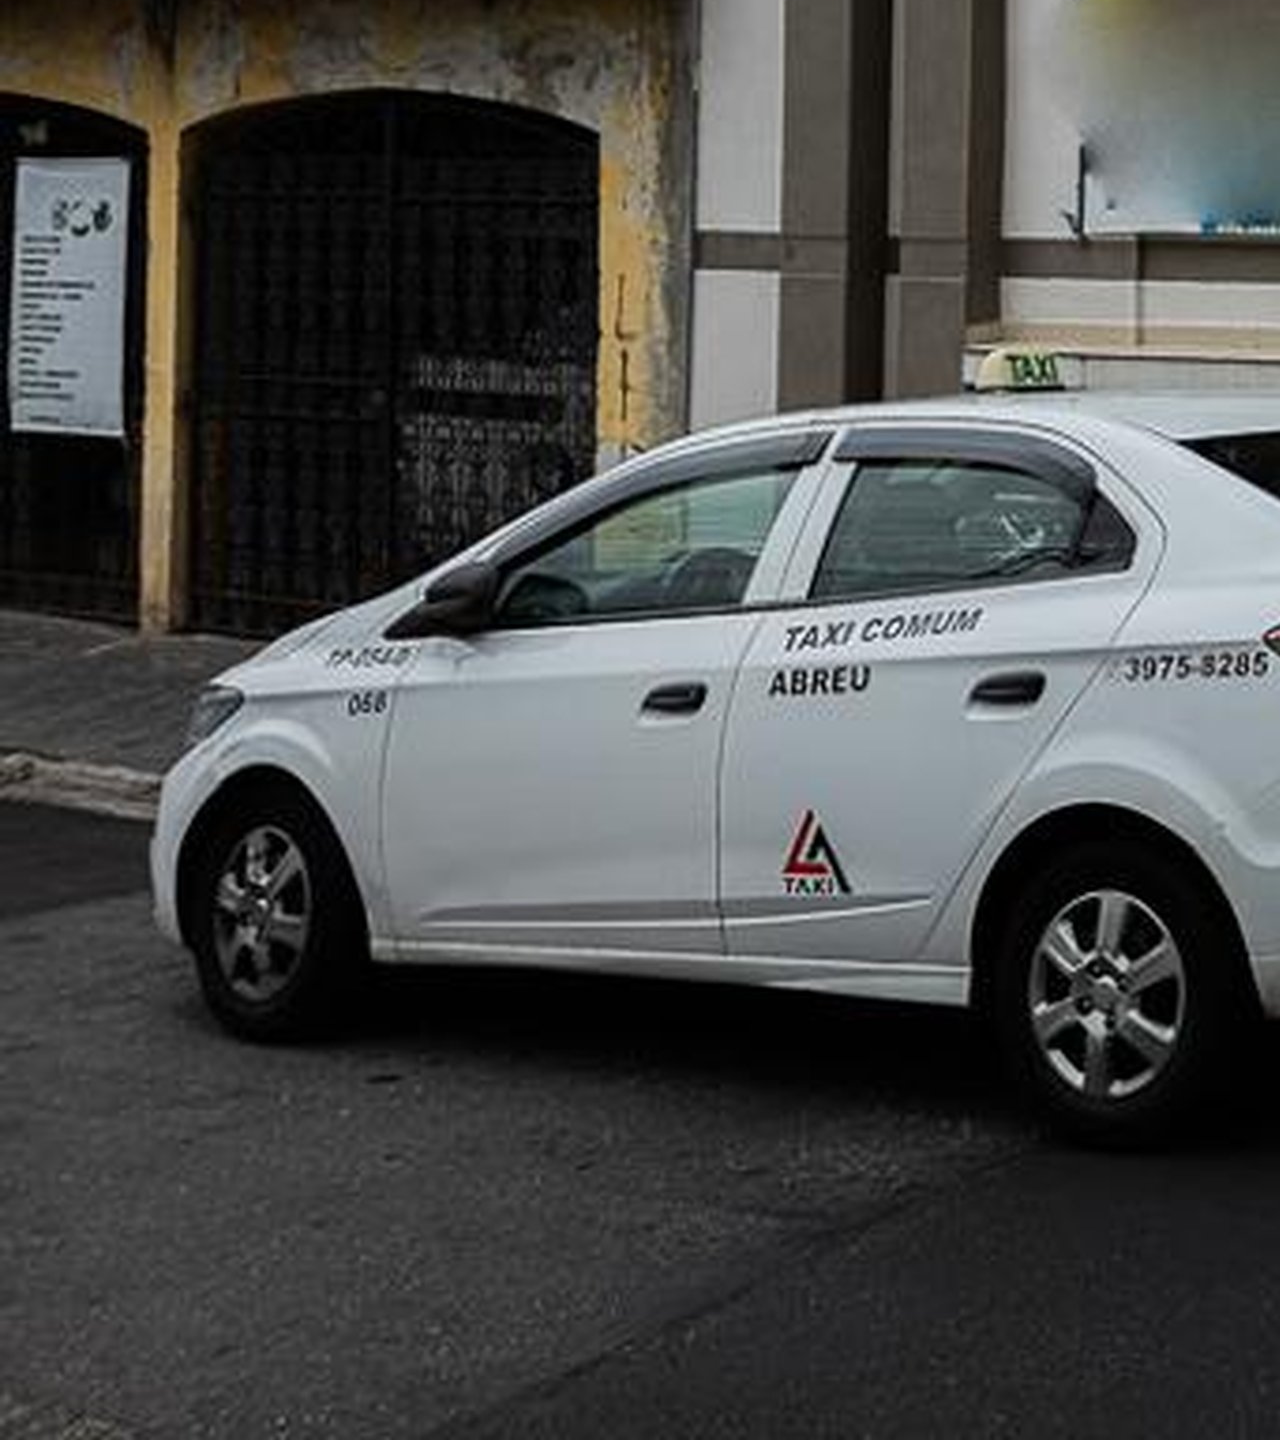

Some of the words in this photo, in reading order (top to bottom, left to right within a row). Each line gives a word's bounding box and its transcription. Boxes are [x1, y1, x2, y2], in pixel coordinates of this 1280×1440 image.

[1005, 353, 1059, 382] TAXI
[783, 620, 856, 652] TAXI
[860, 608, 984, 643] COMUM
[768, 664, 872, 697] ABREU
[781, 877, 835, 895] TAXI
